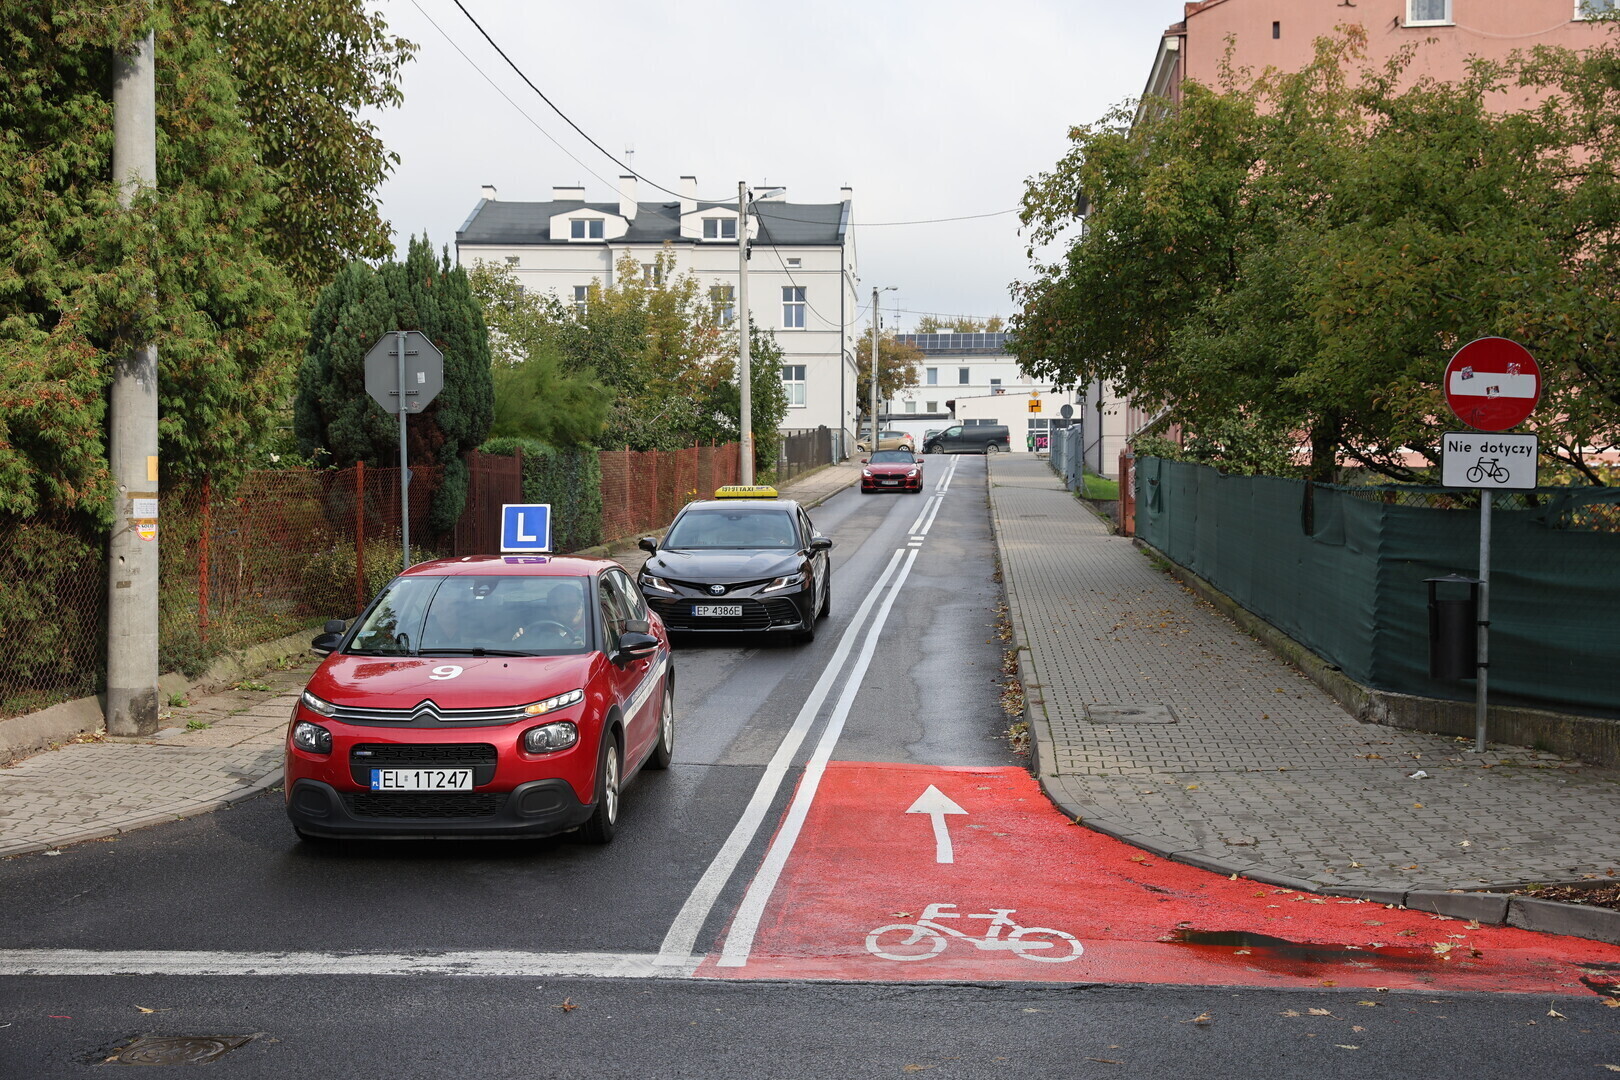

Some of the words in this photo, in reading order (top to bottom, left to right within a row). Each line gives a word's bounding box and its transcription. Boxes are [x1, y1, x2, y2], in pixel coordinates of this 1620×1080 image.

[1448, 440, 1472, 453] Nie
[1480, 441, 1533, 457] dotyczy
[517, 512, 537, 542] L
[697, 606, 709, 616] EP
[712, 606, 740, 616] 4386E
[428, 665, 464, 680] 9
[383, 771, 405, 788] EL
[414, 771, 468, 788] 1T247
